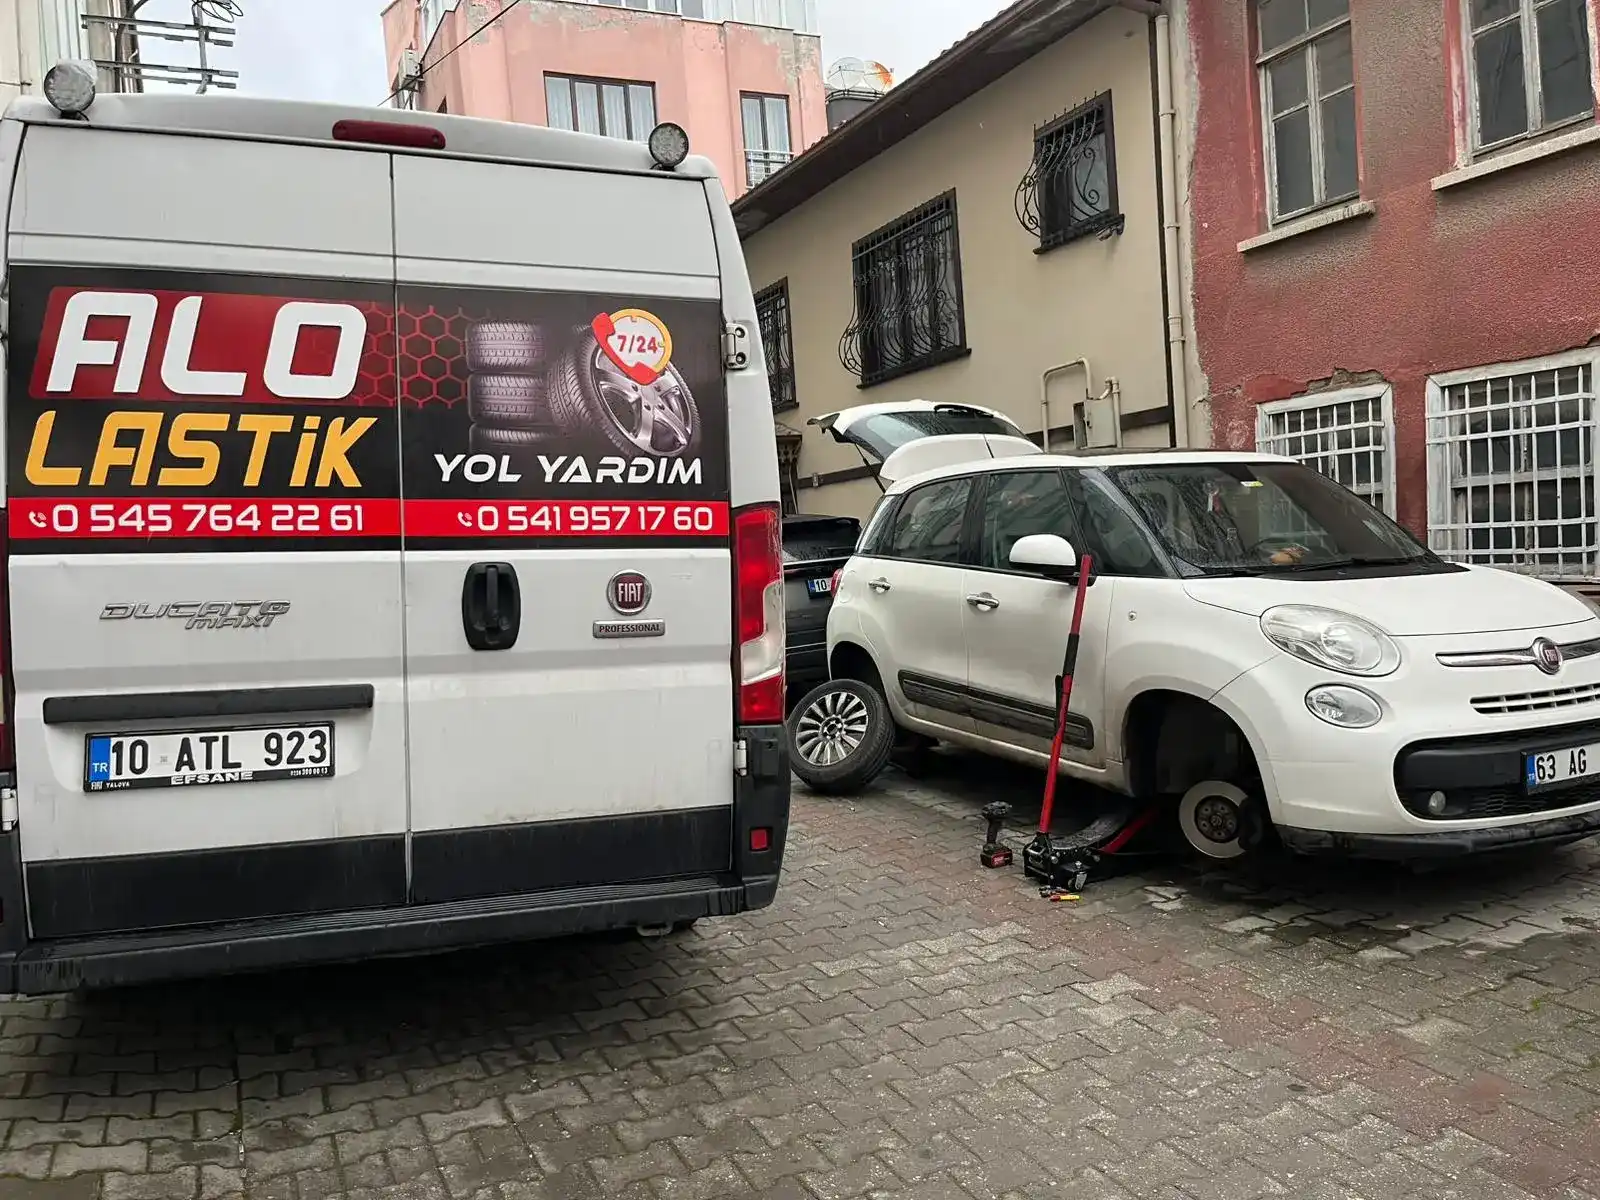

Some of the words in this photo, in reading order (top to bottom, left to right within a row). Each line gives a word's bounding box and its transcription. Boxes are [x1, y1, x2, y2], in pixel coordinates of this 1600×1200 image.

[46, 291, 367, 400] ALO
[617, 334, 658, 354] 7/24
[434, 453, 522, 482] YOL
[537, 455, 702, 485] YARDIM
[52, 505, 78, 532] 0
[90, 504, 172, 532] 545
[182, 504, 261, 532] 764
[271, 505, 320, 531] 22
[329, 504, 363, 531] 61
[477, 506, 499, 531] 0
[507, 506, 561, 531] 541
[570, 506, 630, 531] 957
[672, 507, 713, 531] 60
[618, 582, 643, 602] FIAT
[816, 580, 828, 591] 10
[100, 600, 290, 620] DUCATO
[599, 624, 660, 633] PROFESSIONAL
[92, 762, 109, 773] TR
[111, 739, 150, 776] 10
[174, 735, 242, 772] ATL
[263, 730, 327, 767] 923
[1536, 754, 1556, 781] 63
[1569, 748, 1587, 776] AG
[170, 772, 253, 785] EFSANE
